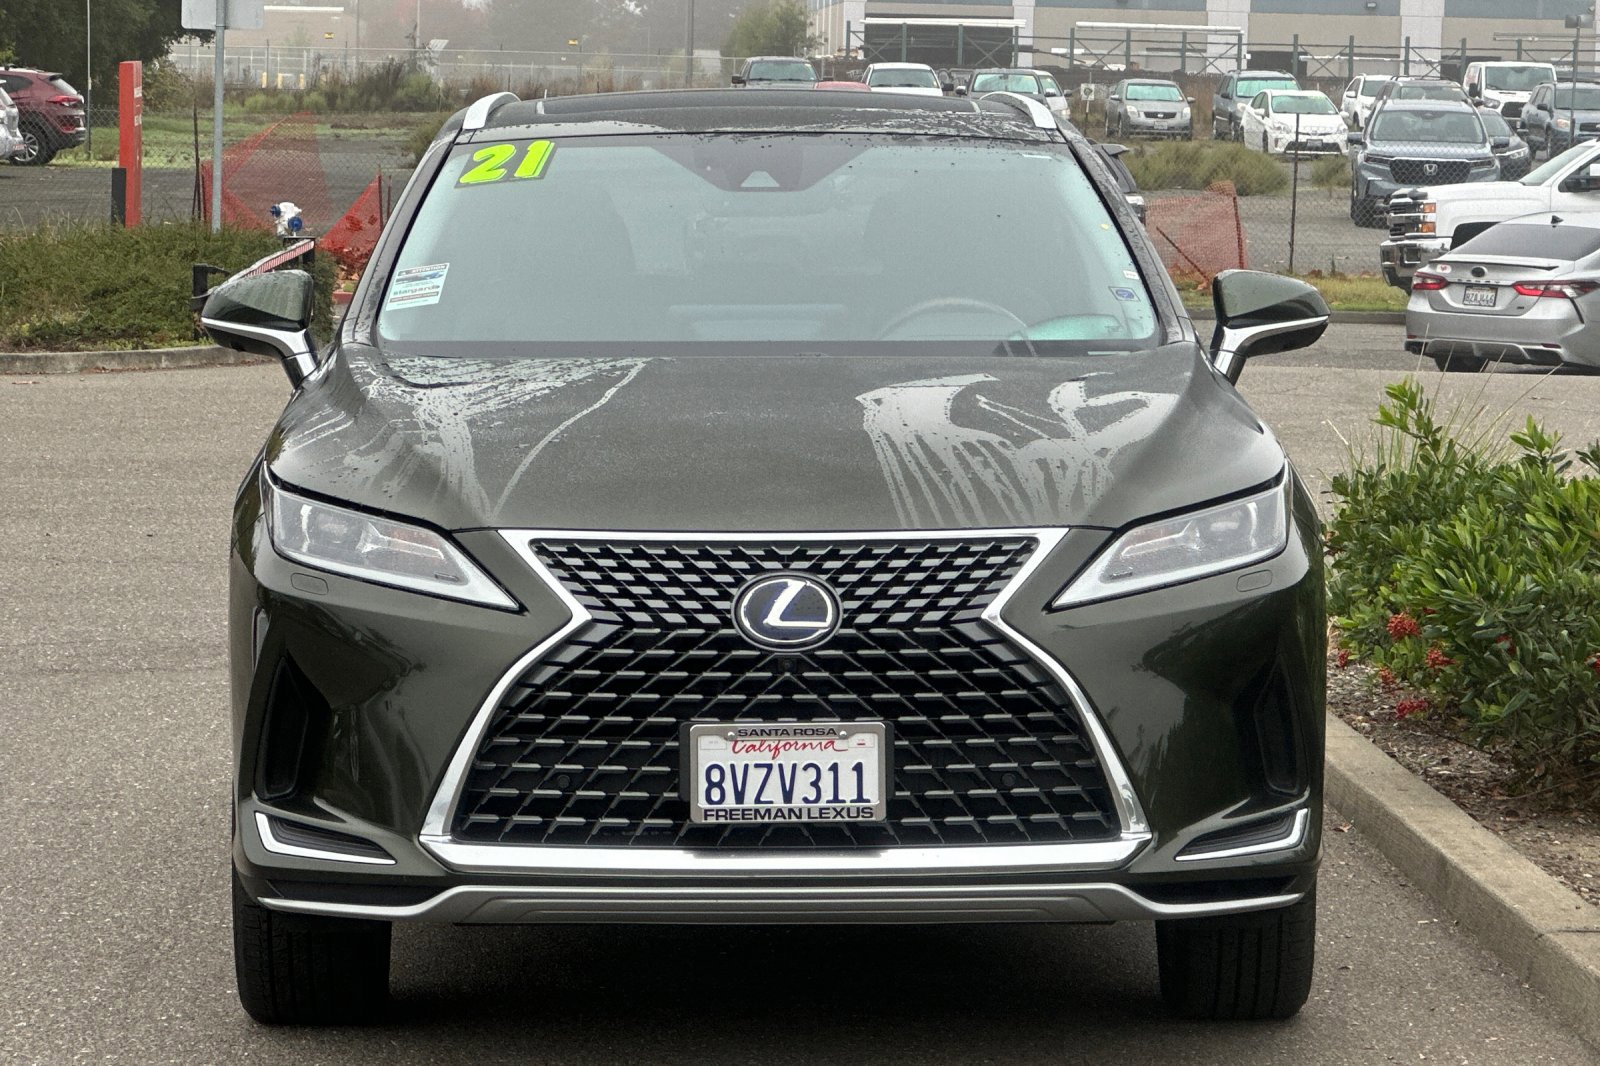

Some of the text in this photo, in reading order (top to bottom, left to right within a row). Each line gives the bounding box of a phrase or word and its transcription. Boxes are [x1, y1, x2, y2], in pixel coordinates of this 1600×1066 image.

[459, 140, 556, 184] 21
[738, 728, 837, 737] SANTA ROSA
[732, 739, 848, 760] California
[705, 762, 871, 805] 8VZV311
[703, 806, 874, 821] FREEMAN LEXUS
